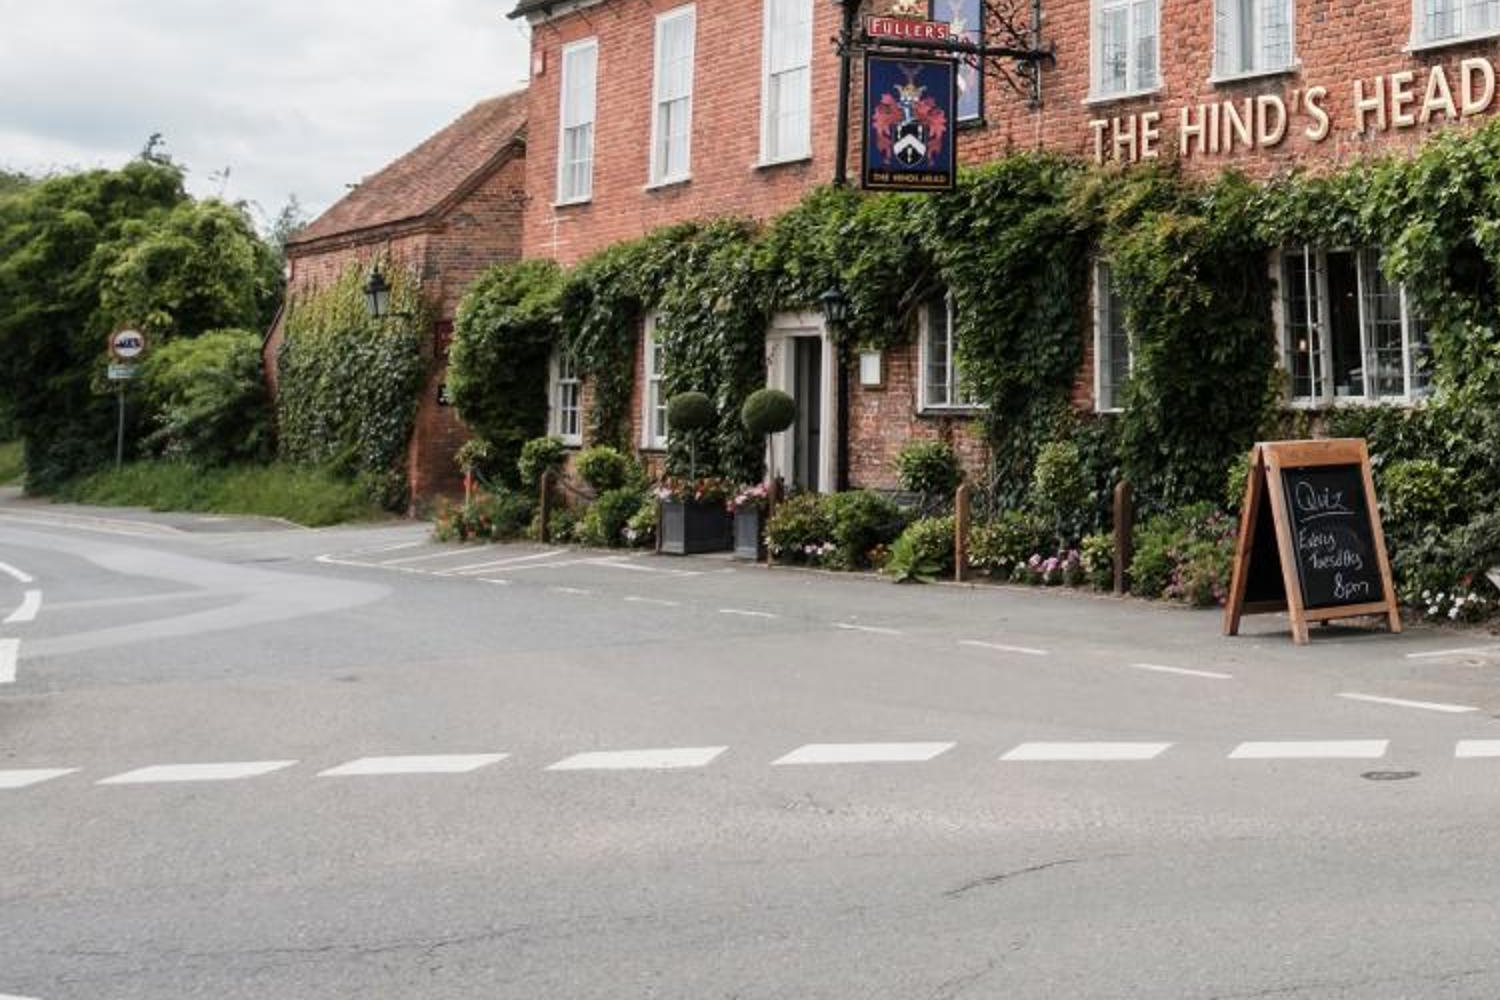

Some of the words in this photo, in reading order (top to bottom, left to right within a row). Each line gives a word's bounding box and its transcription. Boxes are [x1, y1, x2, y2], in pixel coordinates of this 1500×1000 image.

[871, 17, 946, 39] FULLER'S
[1089, 111, 1160, 165] THE
[1180, 85, 1329, 155] HIND'S
[1353, 57, 1496, 134] HEAD
[1296, 481, 1348, 511] Quiz
[1299, 527, 1337, 553] Every
[1334, 572, 1369, 599] 8pm
